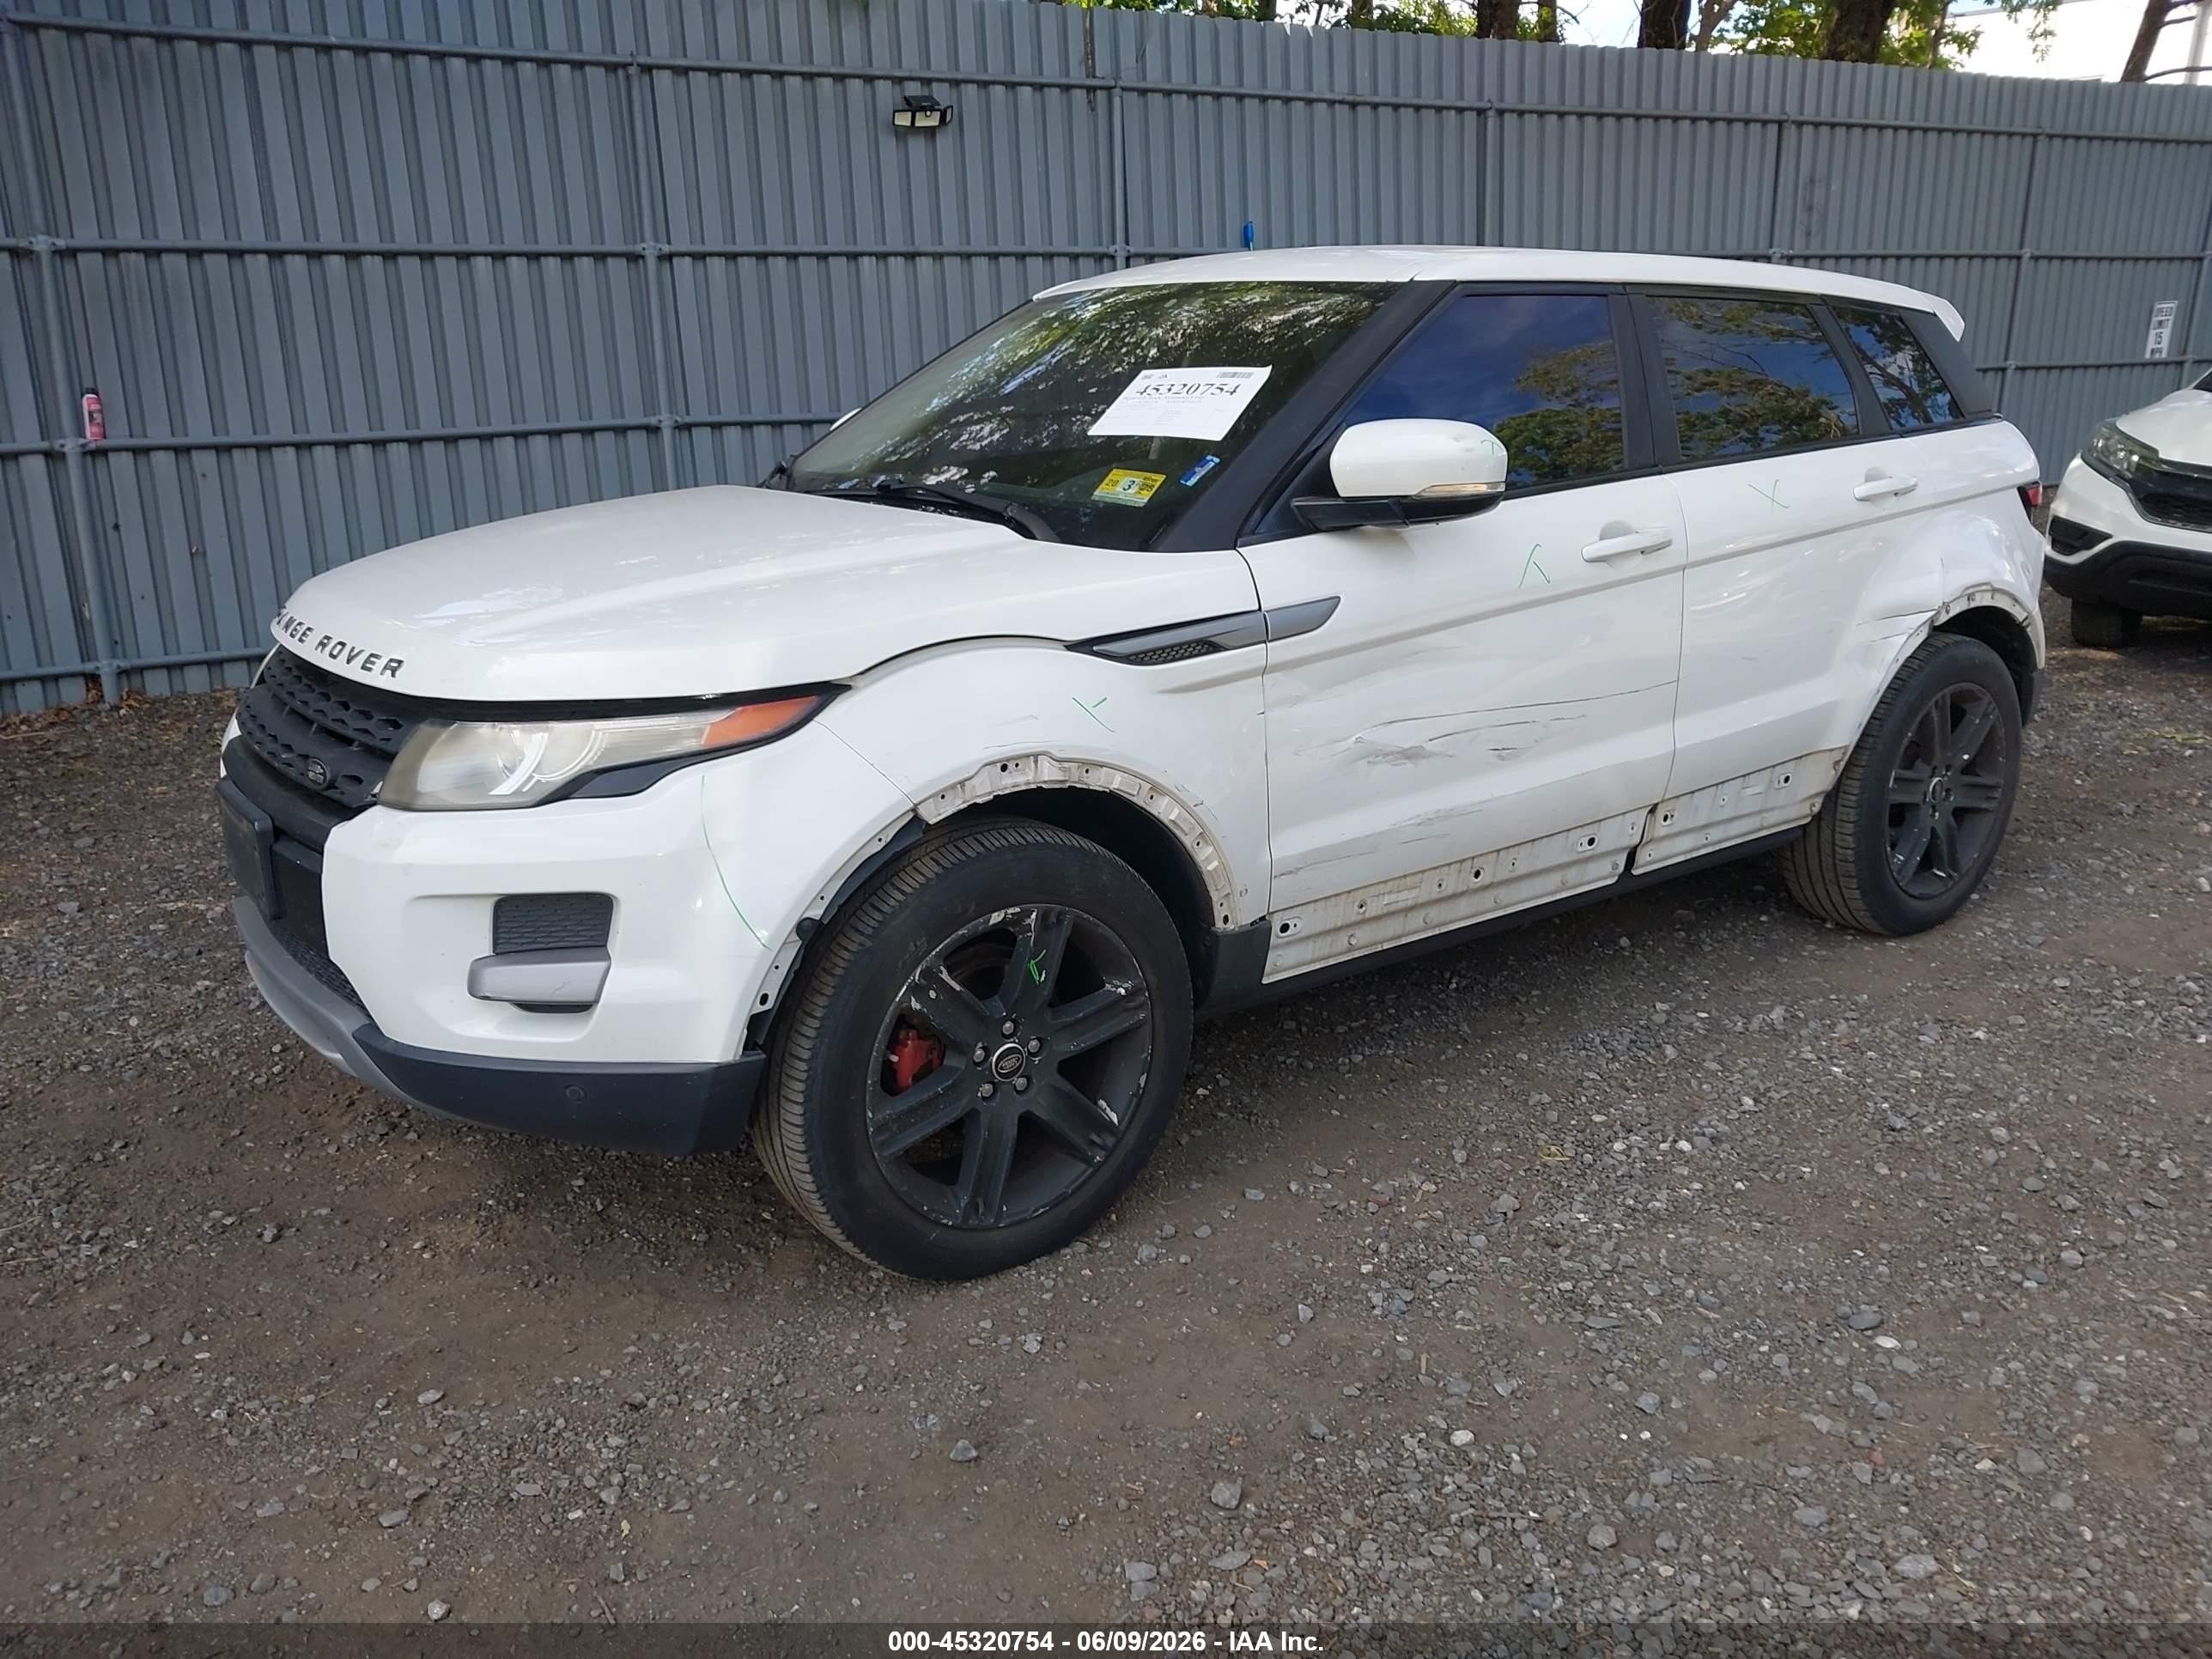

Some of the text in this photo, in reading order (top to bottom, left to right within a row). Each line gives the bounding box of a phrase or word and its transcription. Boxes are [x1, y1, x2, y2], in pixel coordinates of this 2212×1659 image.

[2154, 331, 2164, 345] 15
[1135, 383, 1242, 396] 45320754
[1122, 480, 1136, 492] 3
[314, 635, 404, 678] ROVER
